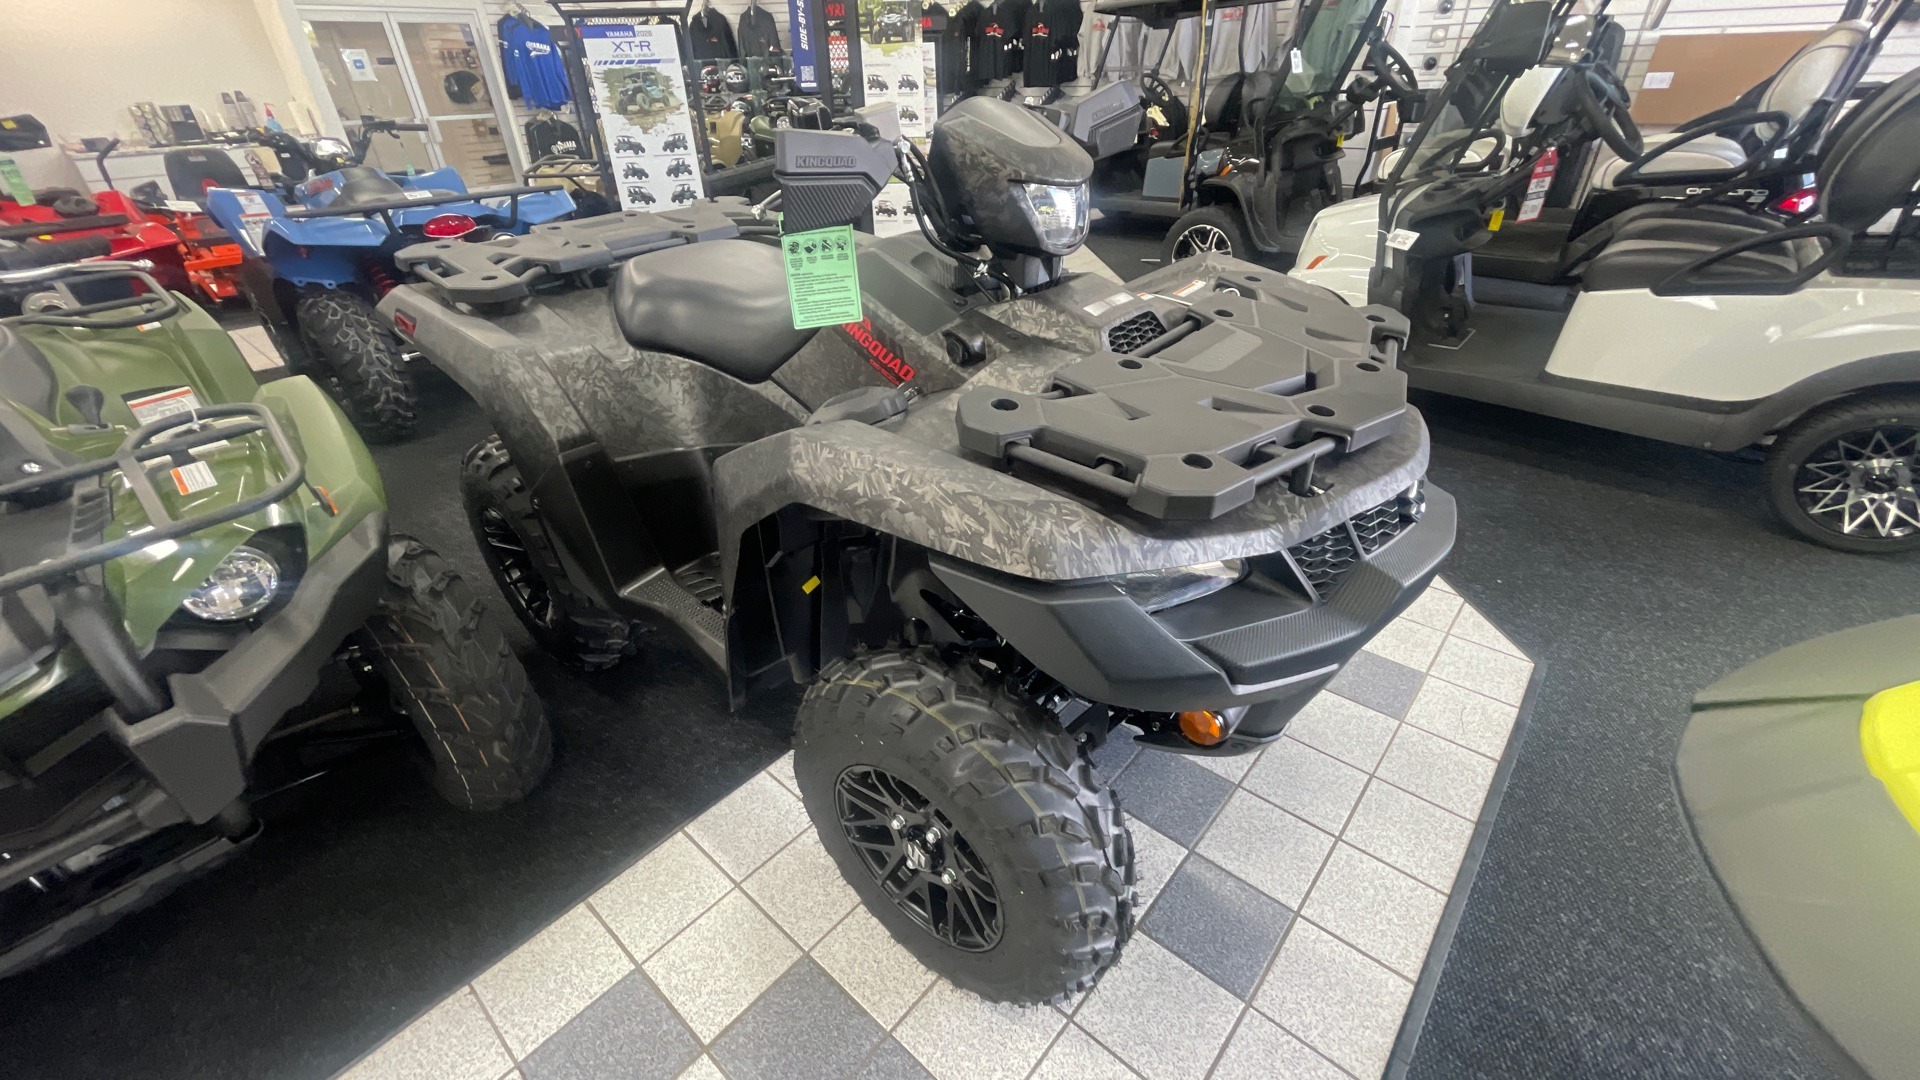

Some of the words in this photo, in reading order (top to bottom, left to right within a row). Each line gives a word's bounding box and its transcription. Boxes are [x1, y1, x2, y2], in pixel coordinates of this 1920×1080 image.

[612, 40, 652, 52] XT-R
[796, 156, 856, 168] KINGQUAD
[842, 321, 915, 381] INGQUAD
